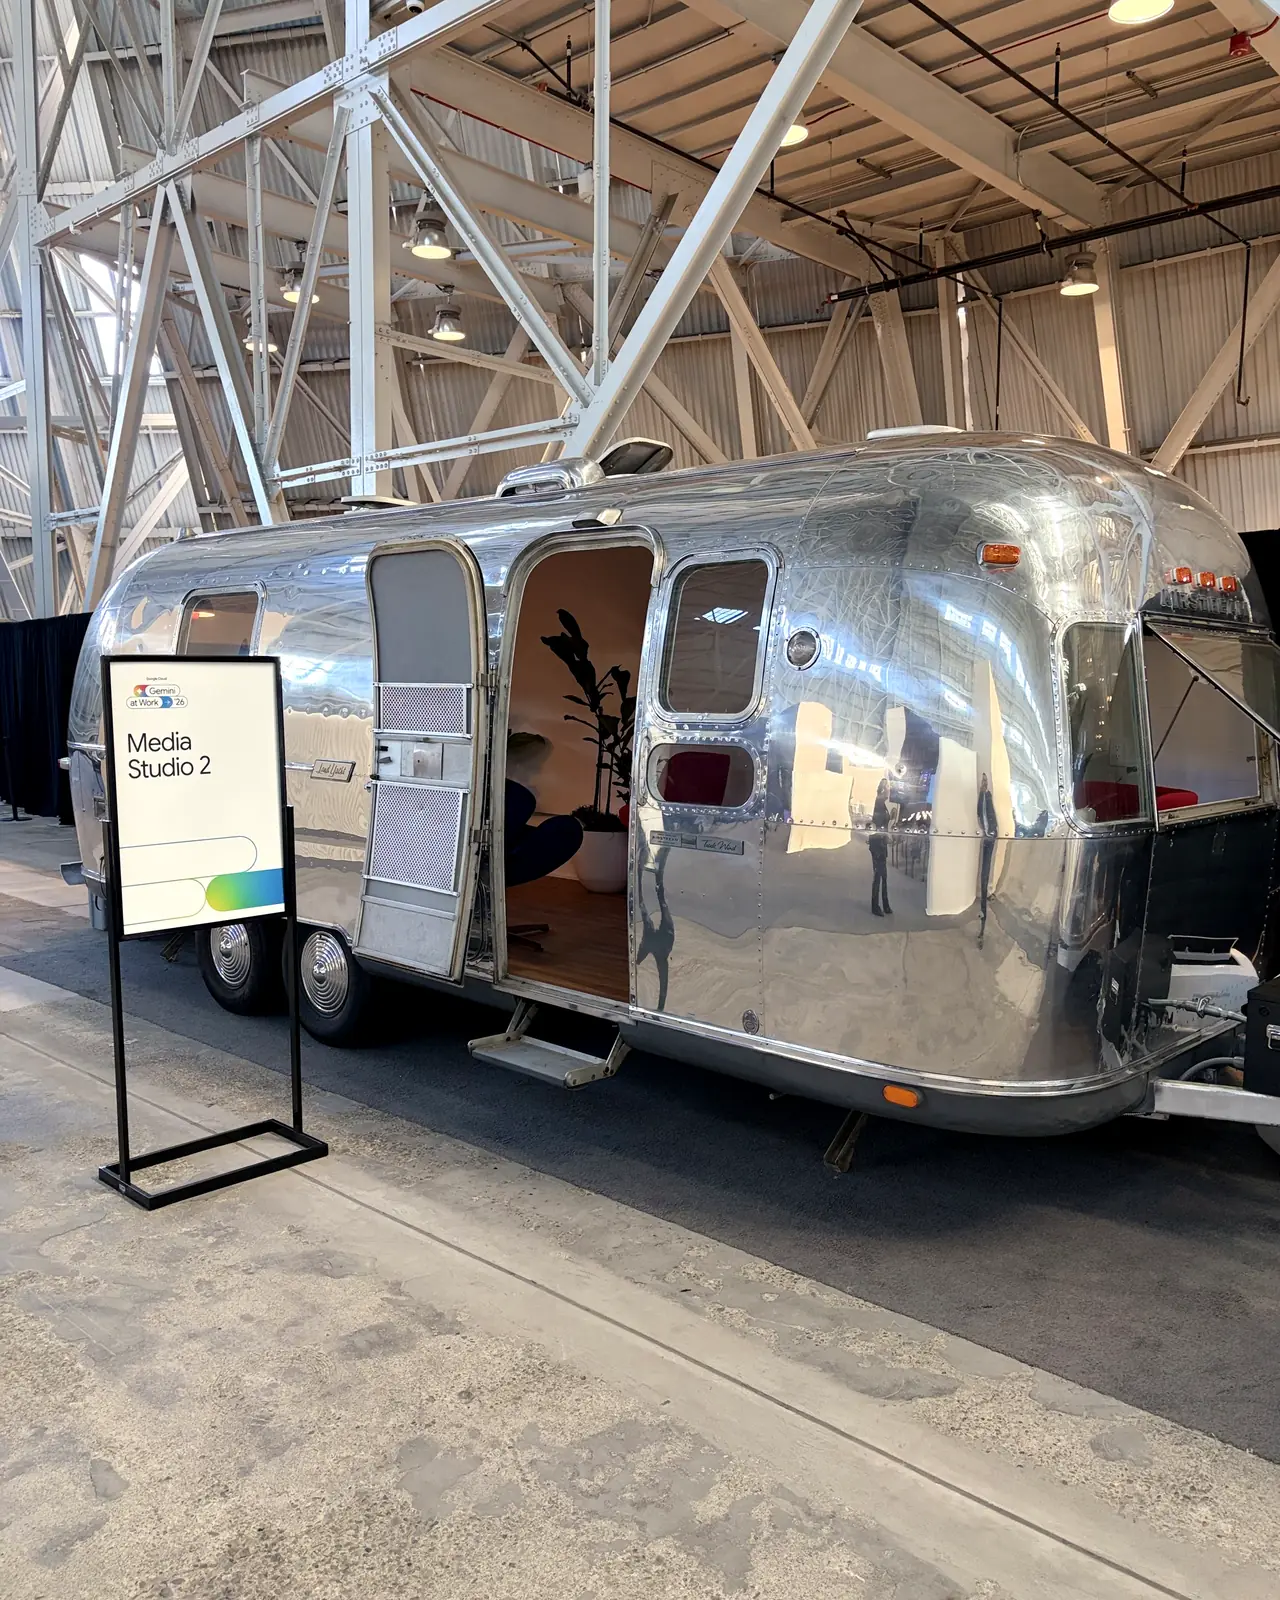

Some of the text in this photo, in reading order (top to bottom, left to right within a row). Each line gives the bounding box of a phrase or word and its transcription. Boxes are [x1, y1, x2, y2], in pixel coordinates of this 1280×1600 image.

[149, 687, 176, 695] Gemini
[139, 698, 159, 707] Work
[127, 731, 192, 753] Media
[128, 755, 212, 779] Studio 2
